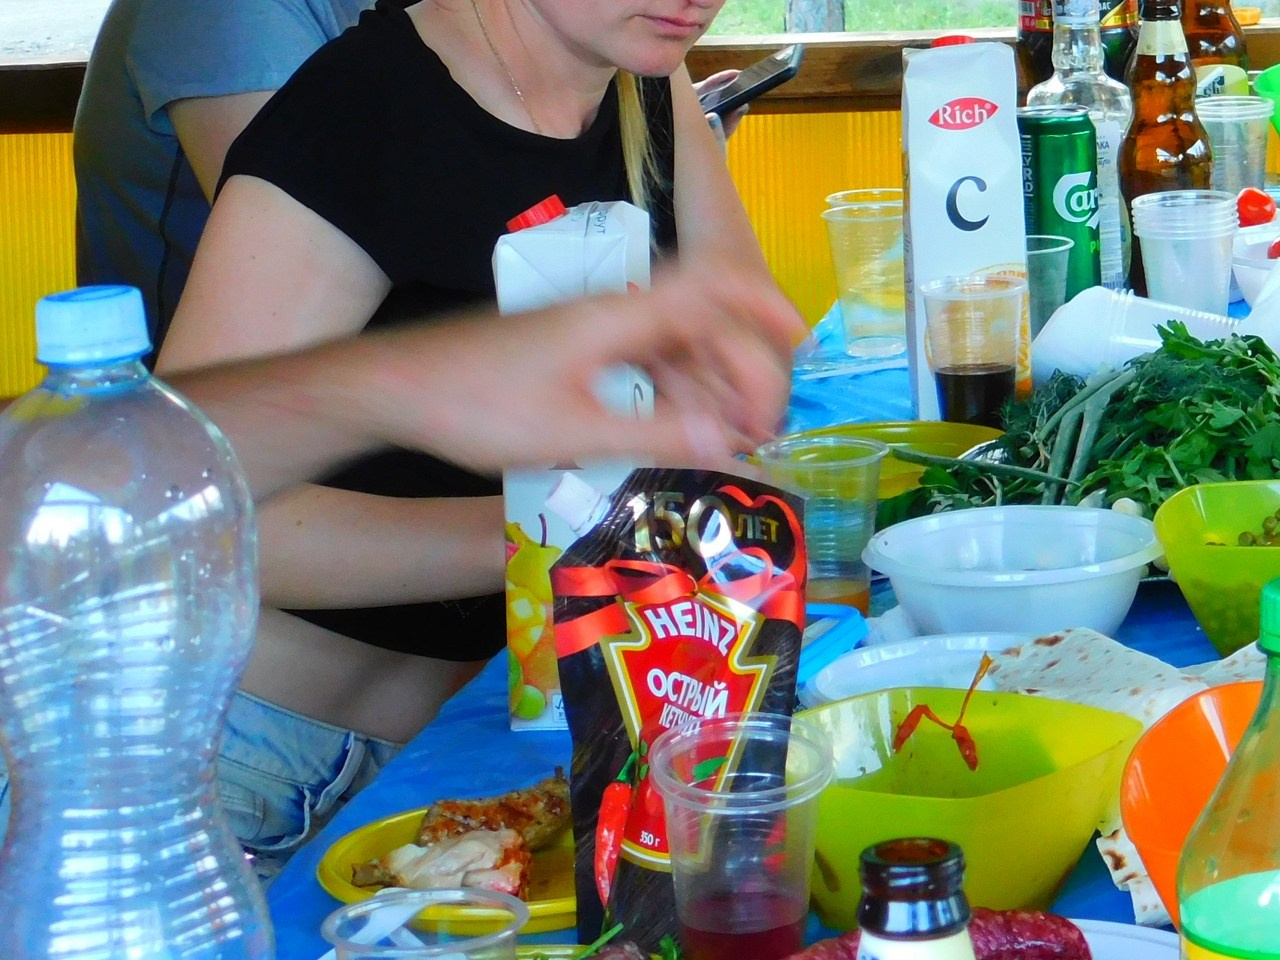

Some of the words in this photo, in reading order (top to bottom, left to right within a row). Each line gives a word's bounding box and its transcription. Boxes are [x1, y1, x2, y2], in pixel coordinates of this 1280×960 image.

[938, 103, 987, 125] Rich
[627, 491, 732, 560] 150
[735, 514, 780, 544] ЛЕТ
[643, 601, 736, 656] HEINZ
[646, 668, 729, 720] ОСТРЫЙ
[639, 830, 654, 845] 350
